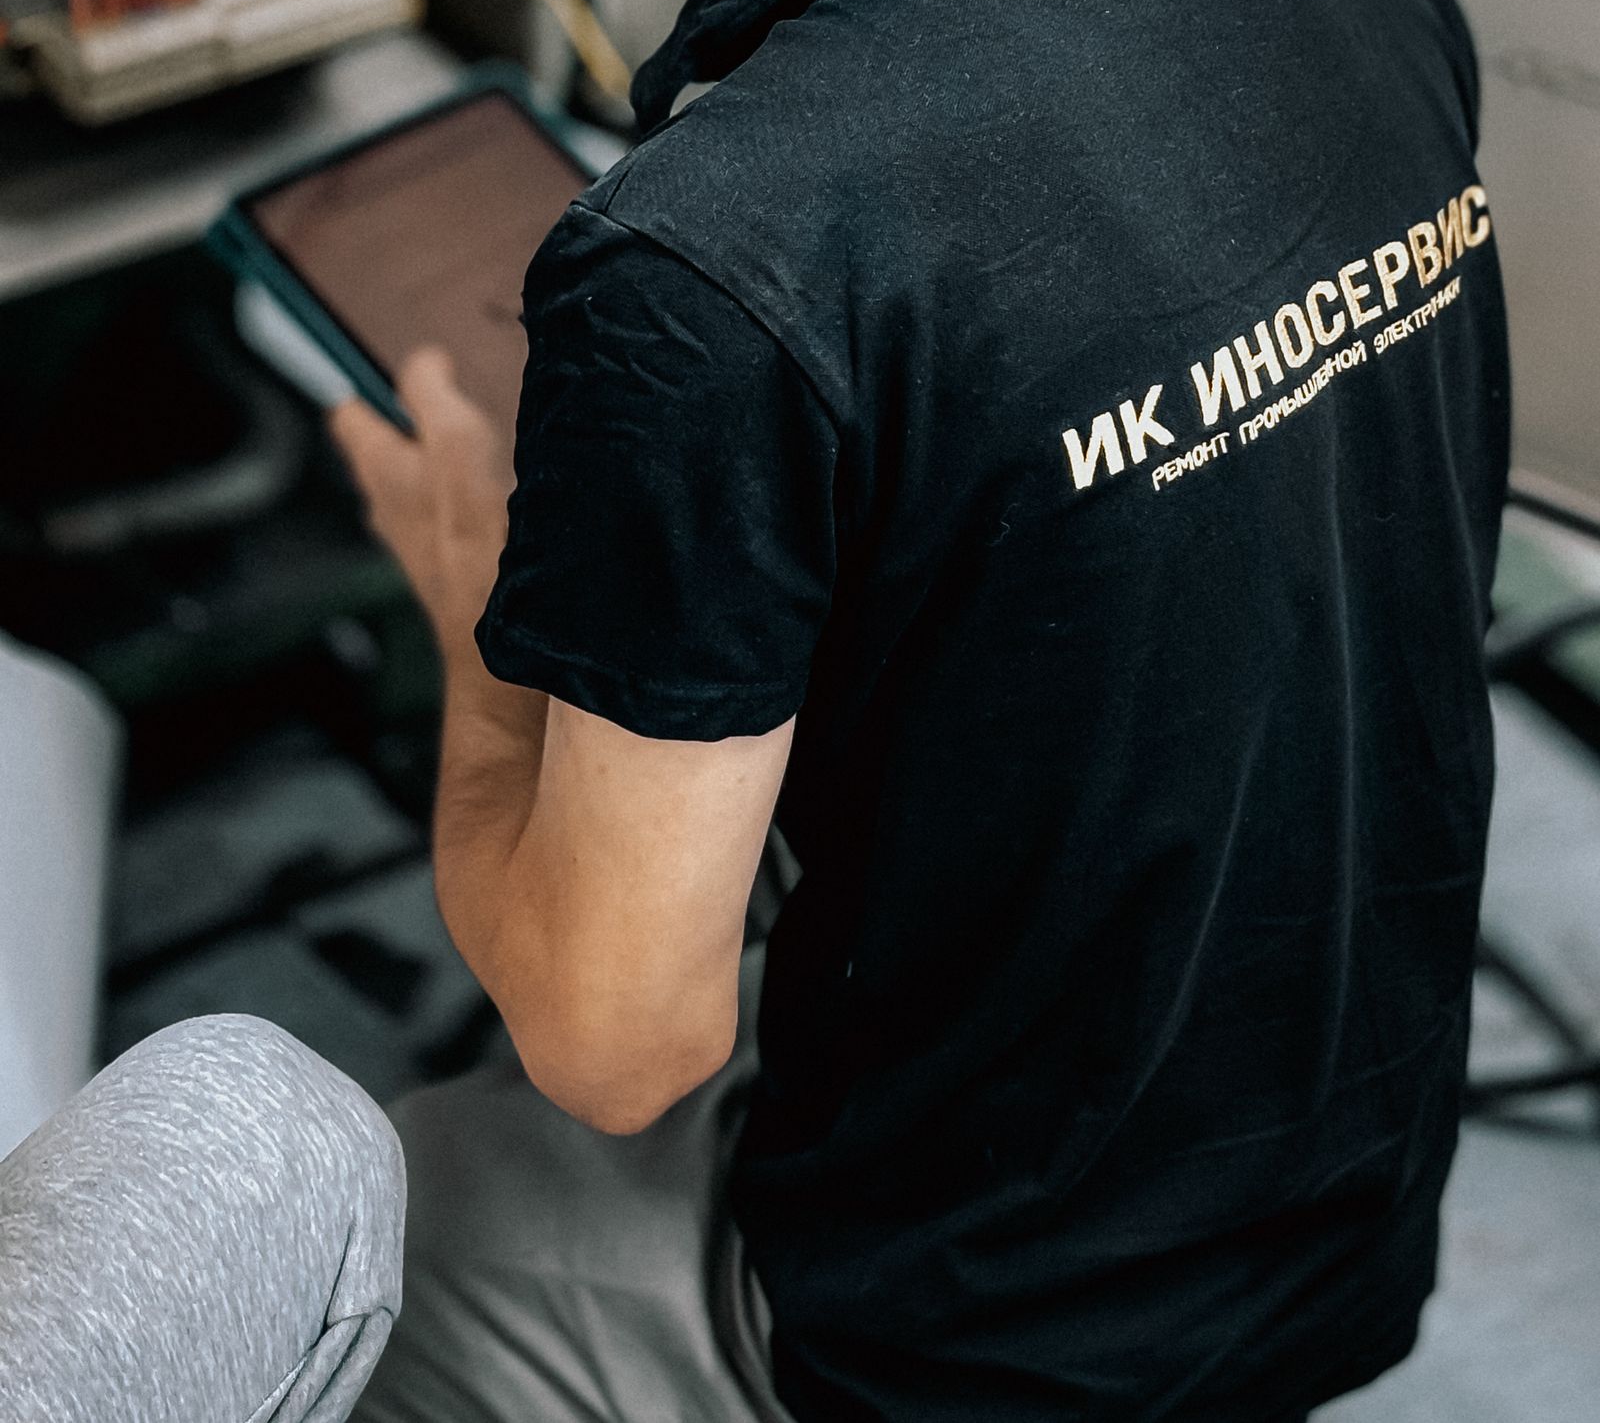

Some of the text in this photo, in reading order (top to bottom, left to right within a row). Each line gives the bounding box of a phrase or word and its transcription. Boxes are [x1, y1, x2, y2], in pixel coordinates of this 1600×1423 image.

[1062, 184, 1490, 490] ИК ИНОСЕРВИС
[1152, 431, 1231, 492] РЕМОНТ
